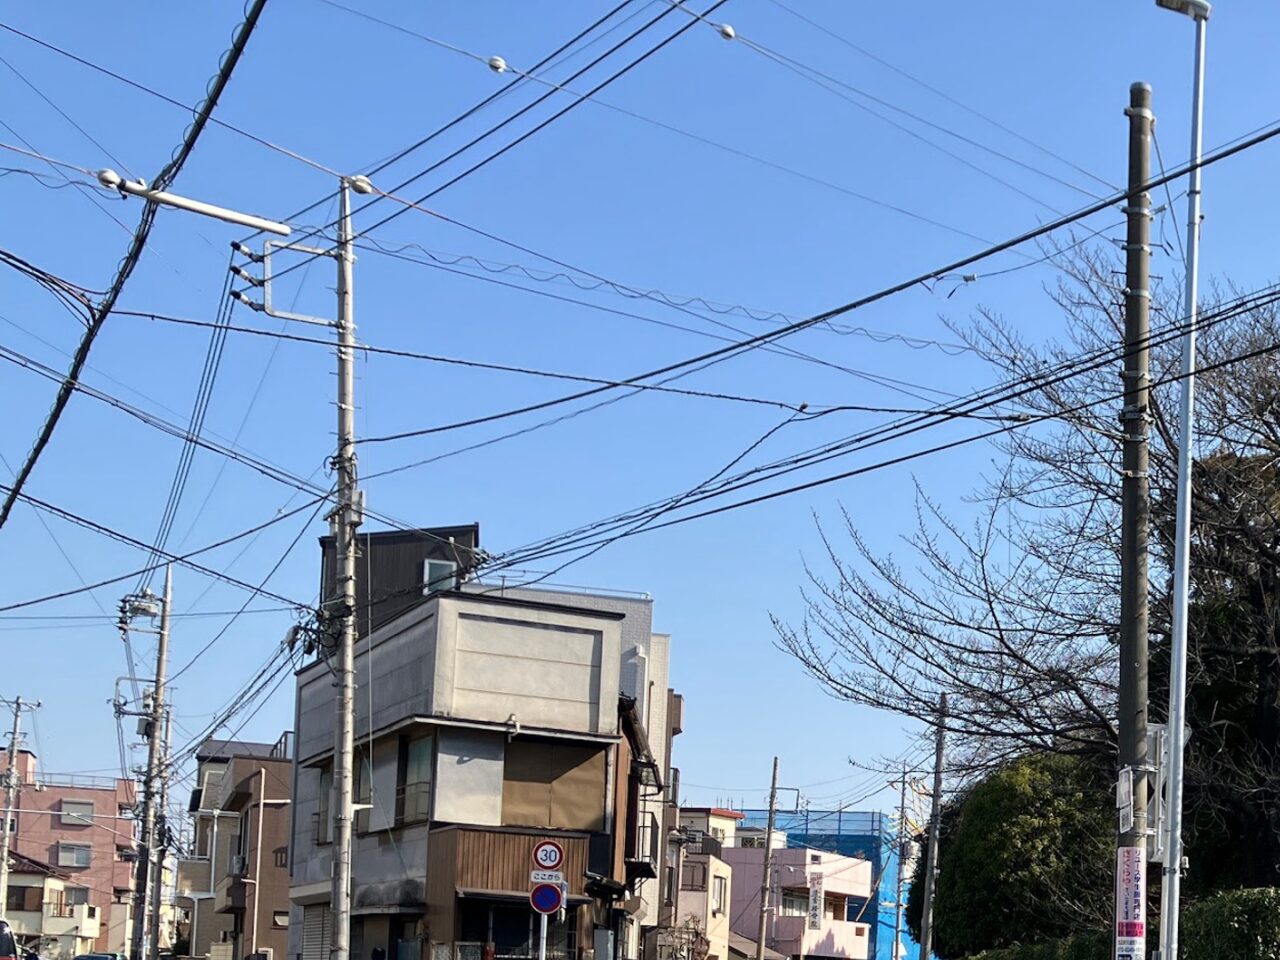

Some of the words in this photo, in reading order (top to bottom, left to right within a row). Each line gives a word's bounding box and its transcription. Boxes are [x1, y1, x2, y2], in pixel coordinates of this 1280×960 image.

[540, 849, 557, 862] 30
[534, 873, 560, 881] ここから
